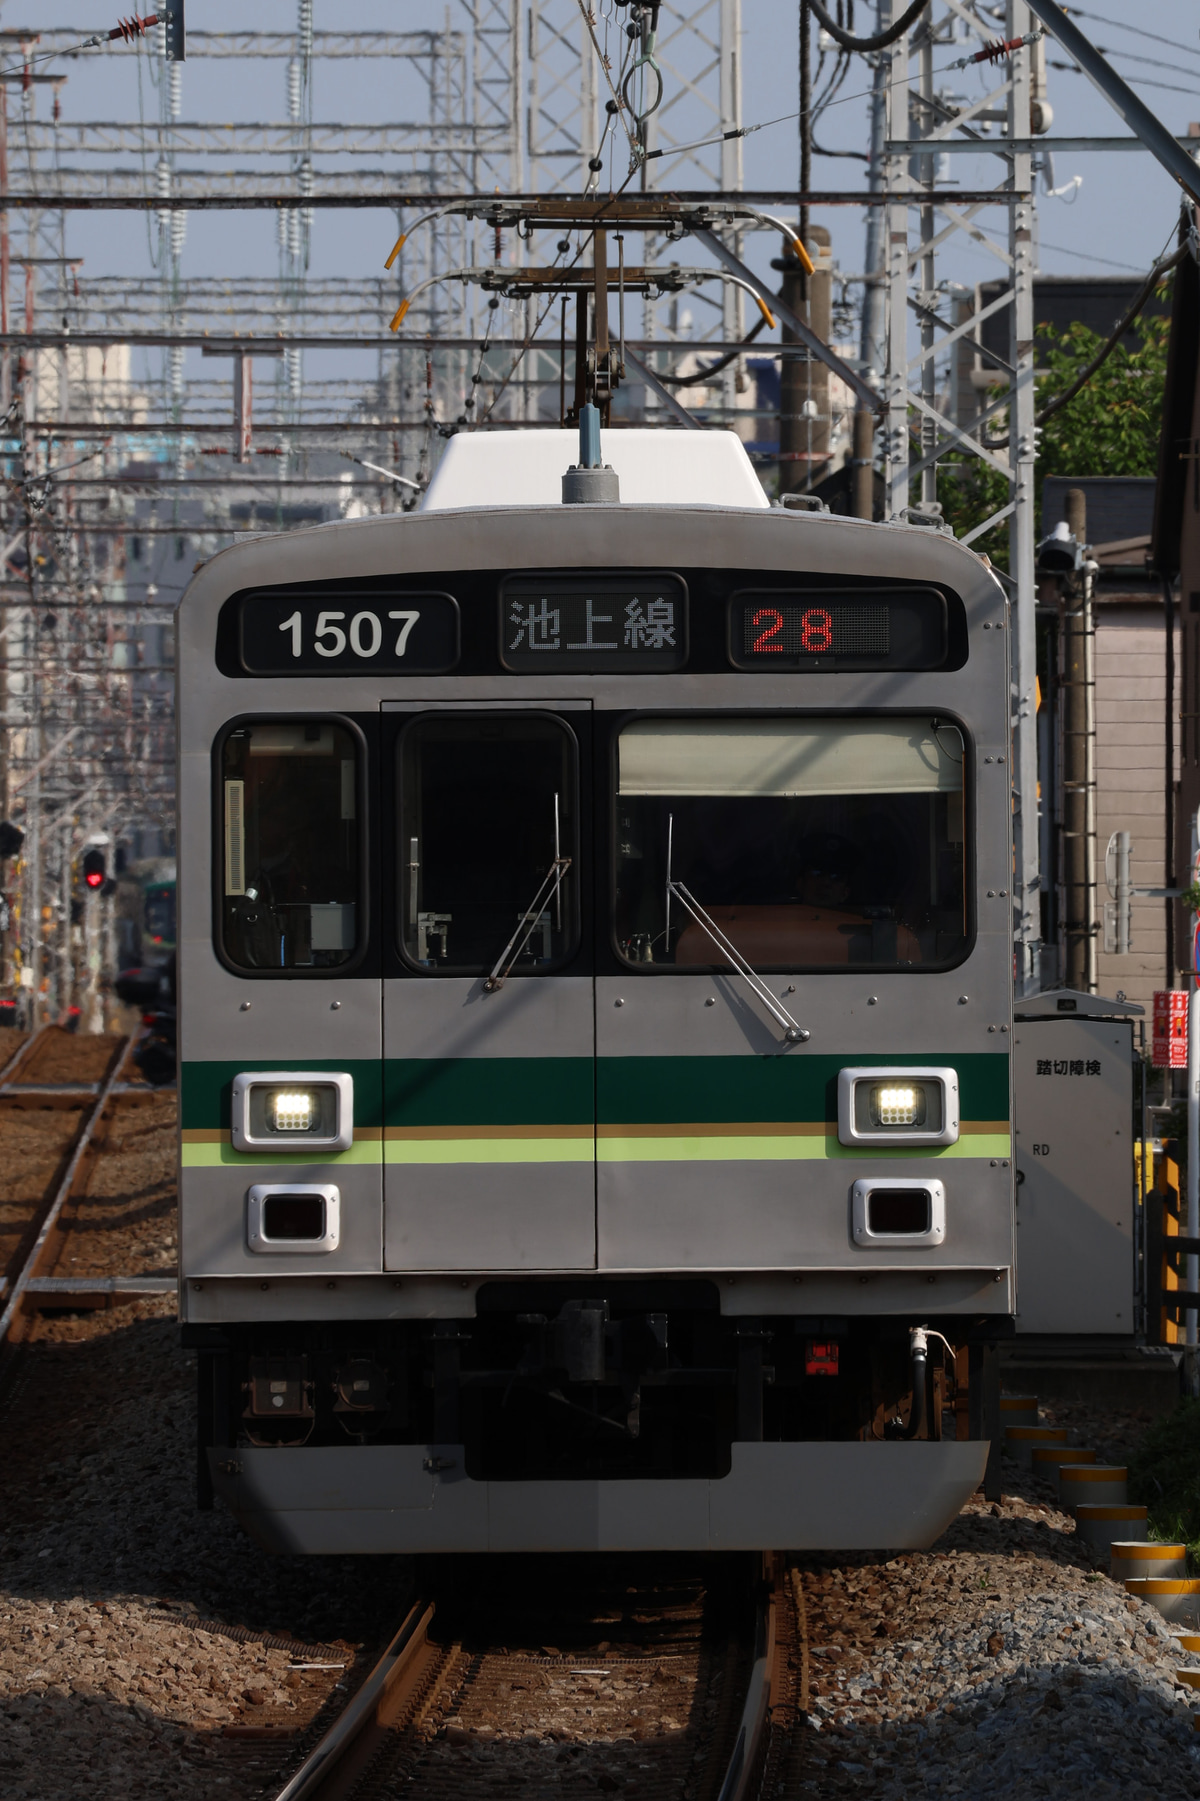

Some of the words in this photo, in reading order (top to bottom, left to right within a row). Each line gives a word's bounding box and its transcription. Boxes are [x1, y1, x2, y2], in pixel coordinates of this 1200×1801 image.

[278, 610, 421, 659] 1507
[509, 597, 677, 650] 池上線
[752, 609, 832, 652] 28
[1036, 1059, 1102, 1077] 踏切障検
[1032, 1143, 1050, 1157] RD
